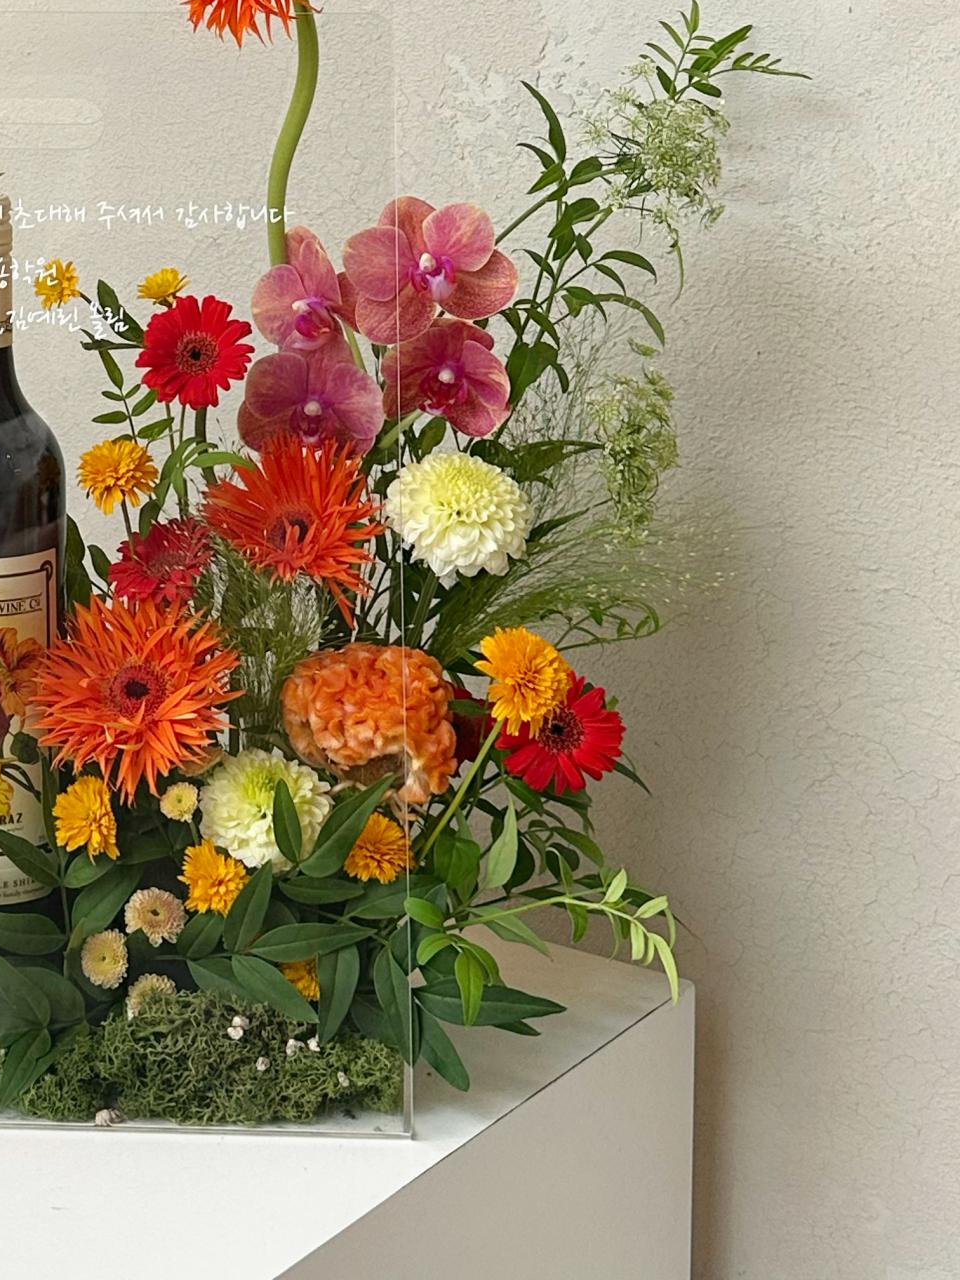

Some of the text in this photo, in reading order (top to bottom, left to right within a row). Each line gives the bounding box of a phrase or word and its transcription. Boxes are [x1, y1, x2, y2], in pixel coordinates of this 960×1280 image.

[10, 198, 86, 229] 초대해
[96, 201, 164, 230] 주셔서
[176, 201, 296, 230] 감사합니다
[88, 300, 129, 341] 올림
